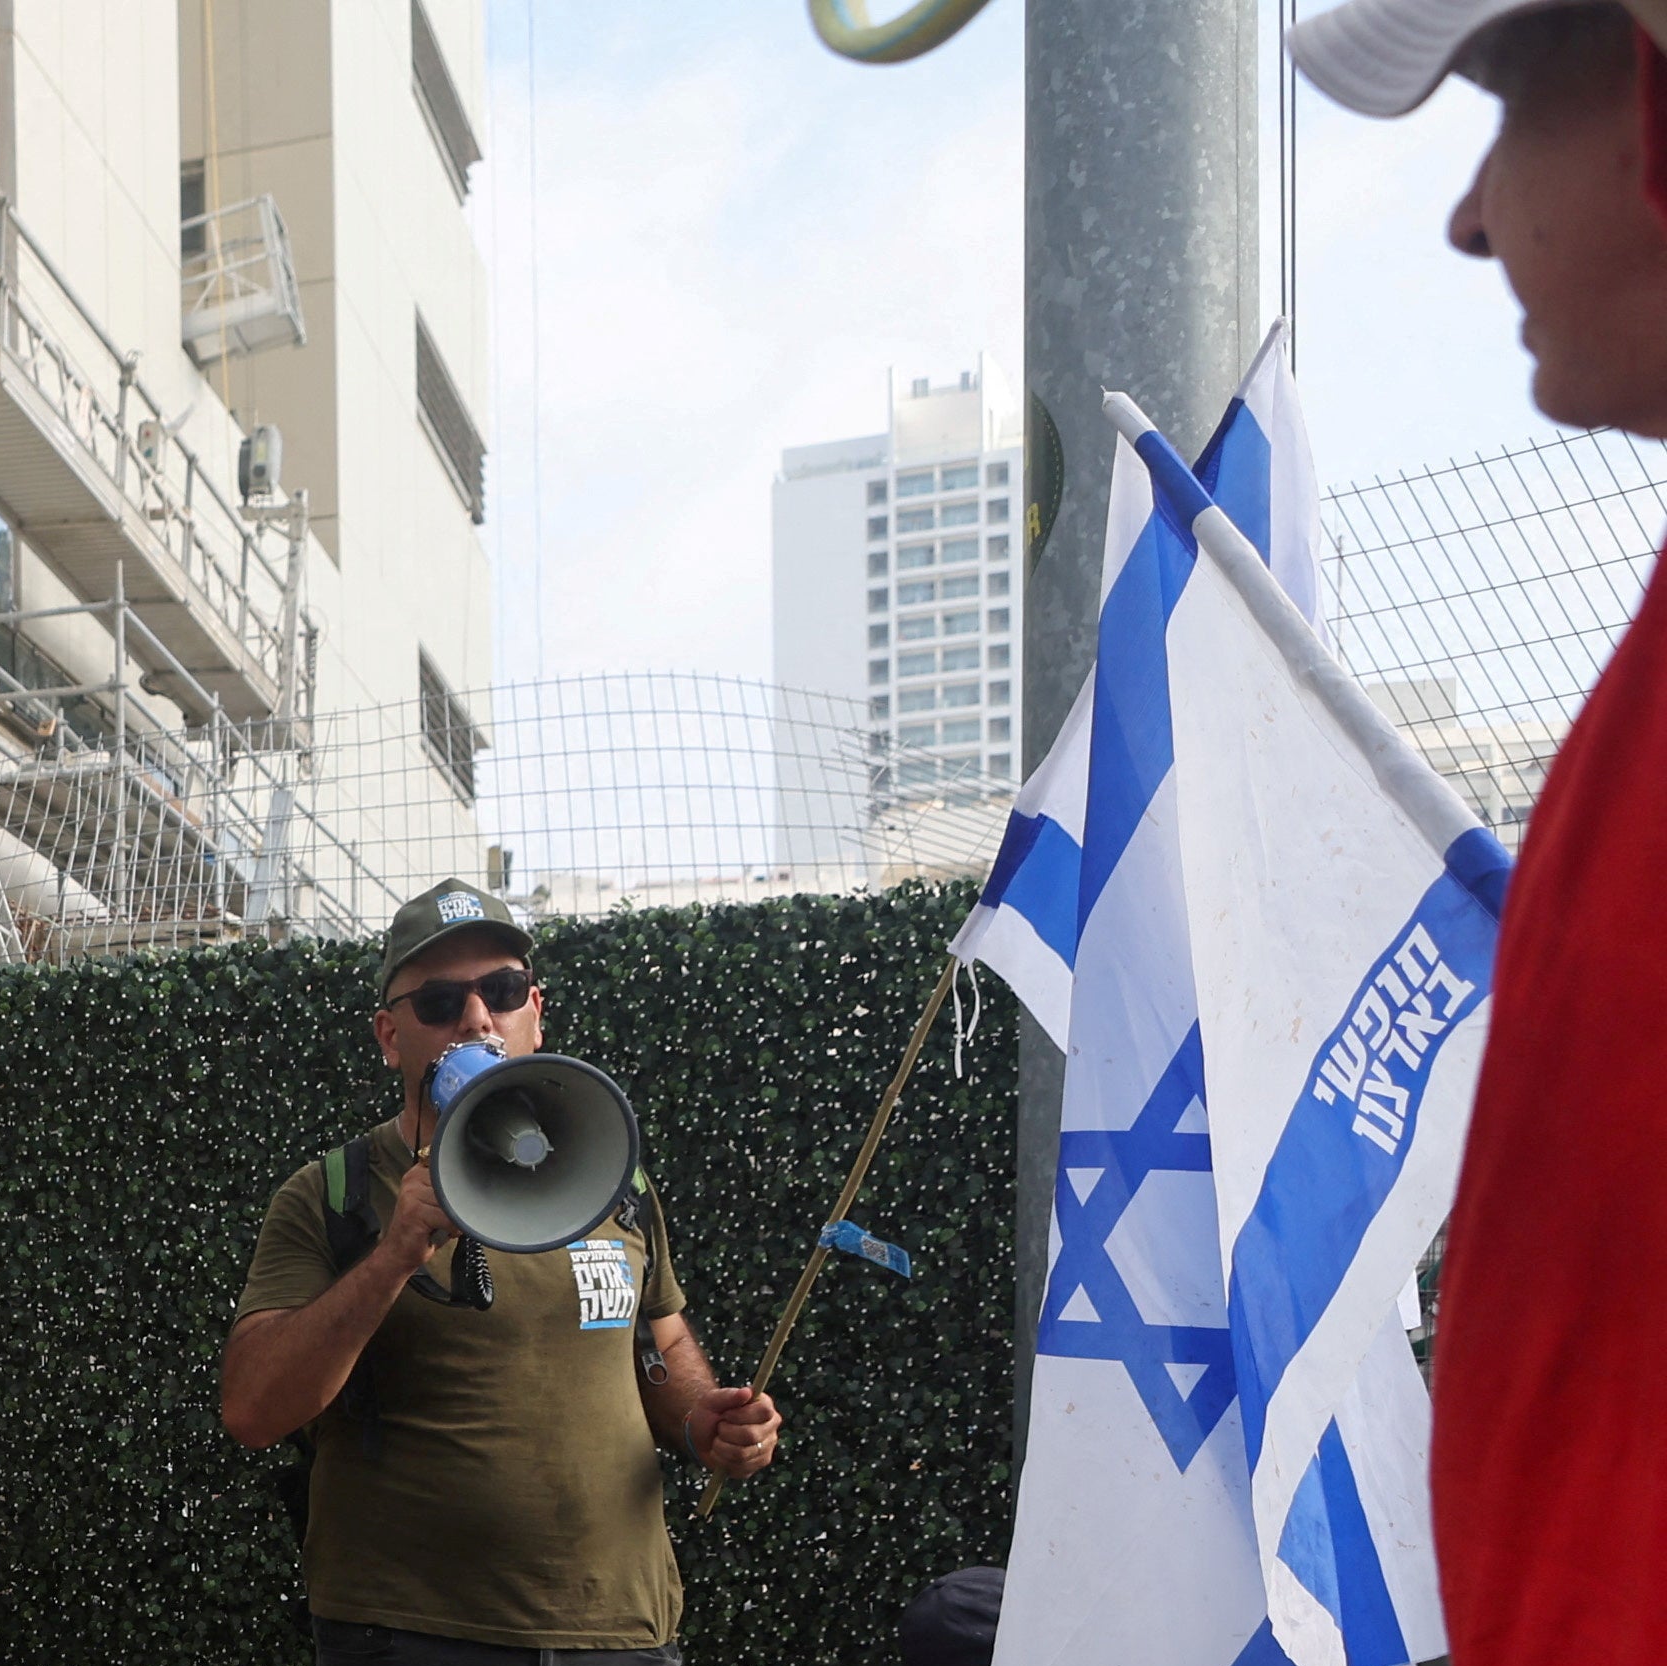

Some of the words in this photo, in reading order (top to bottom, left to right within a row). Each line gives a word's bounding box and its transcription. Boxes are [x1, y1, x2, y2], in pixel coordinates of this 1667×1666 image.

[1312, 922, 1440, 1106] חופשי
[1351, 960, 1476, 1156] בארצנו
[571, 1261, 628, 1291] אחים
[578, 1286, 635, 1324] לנשק
